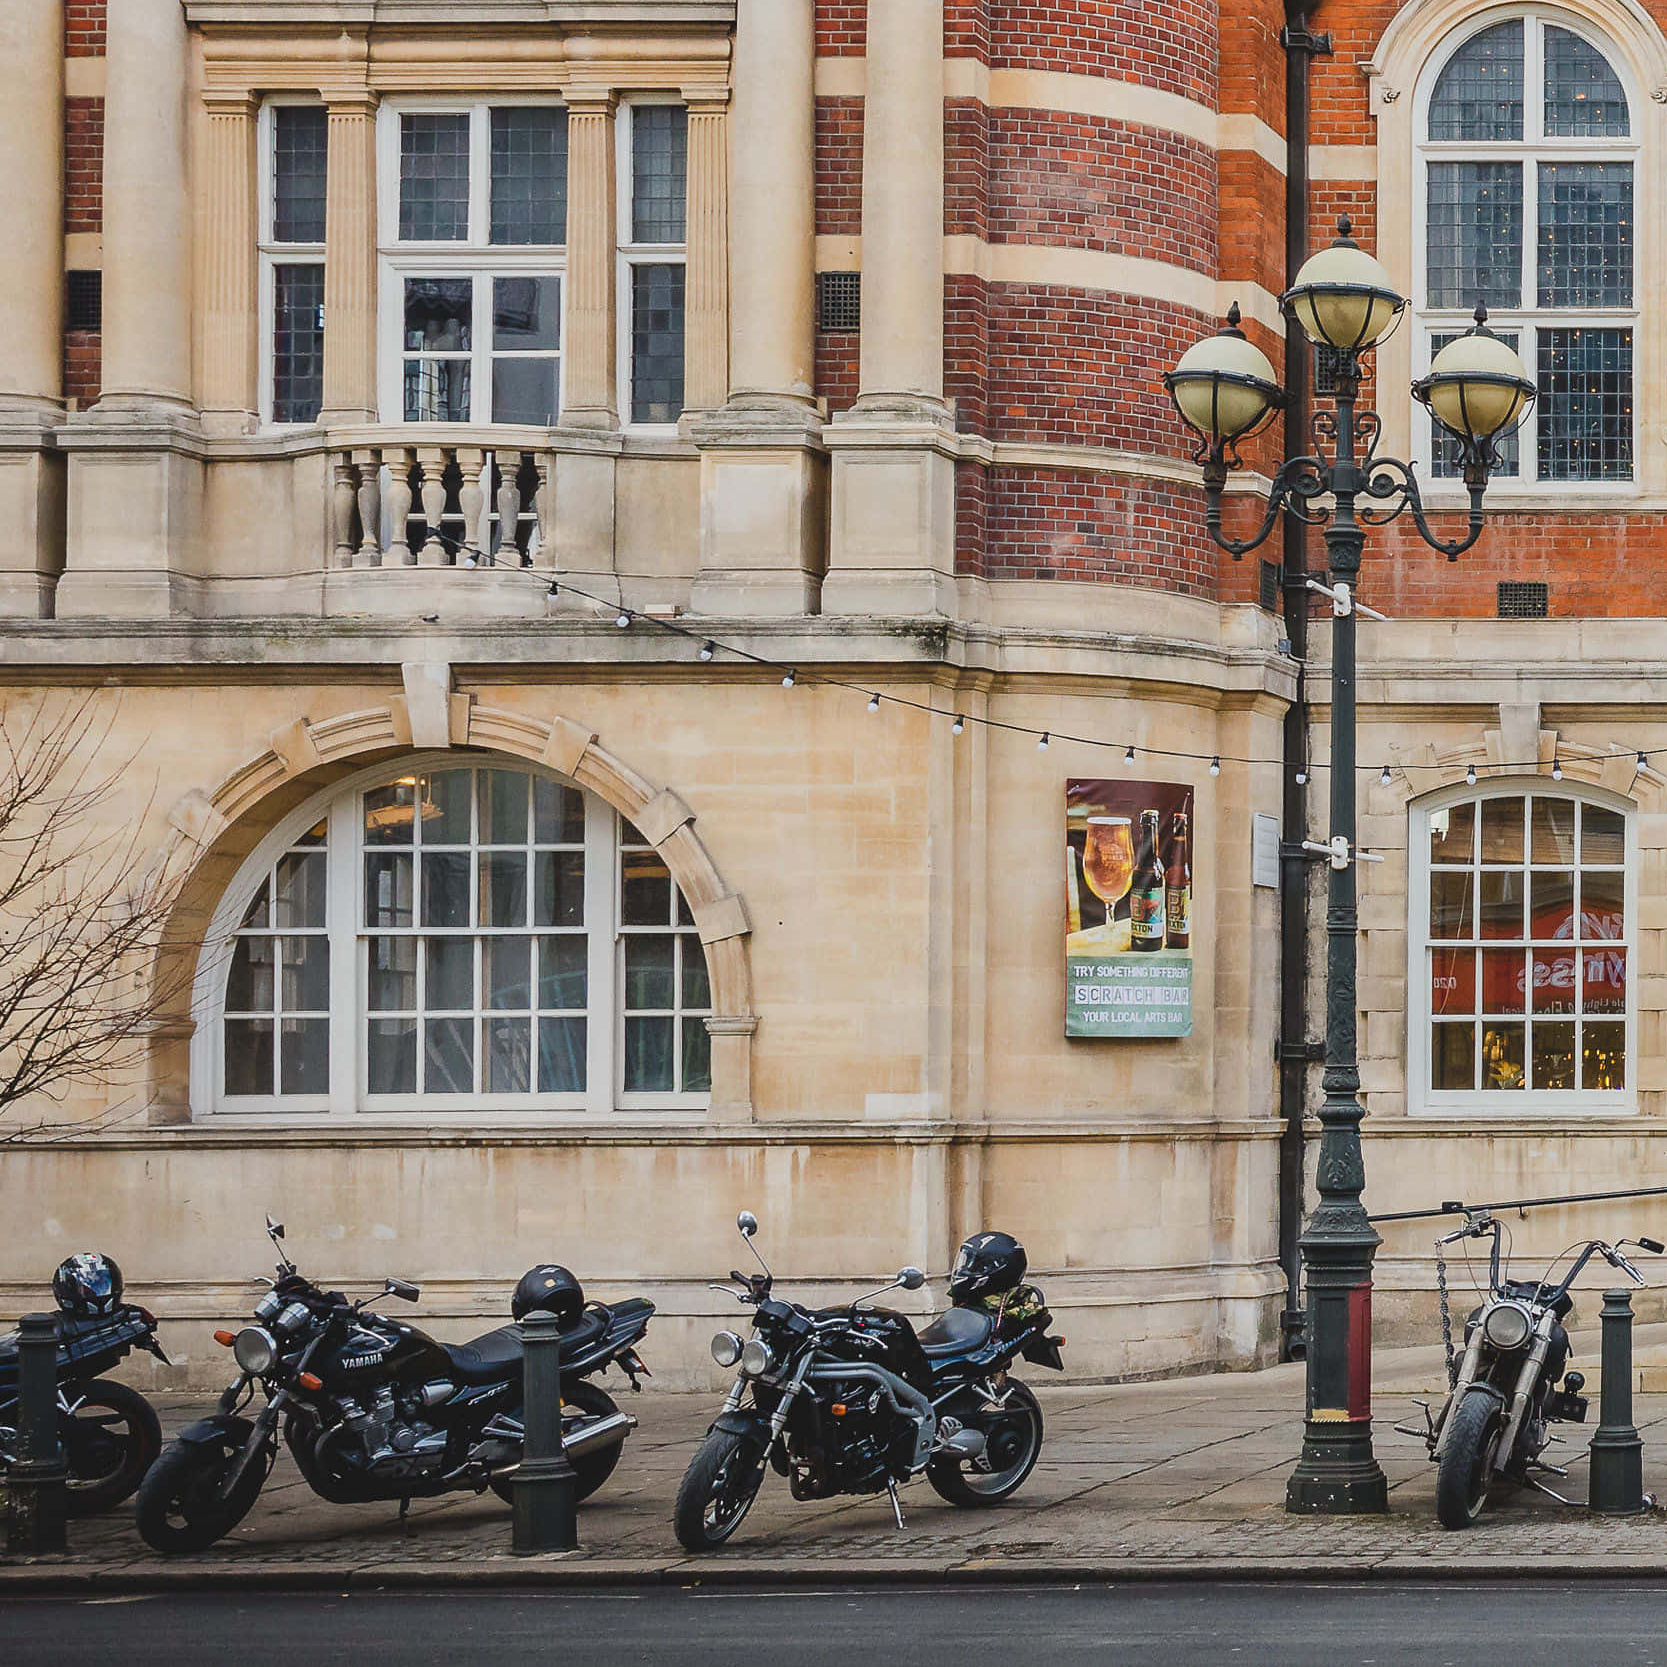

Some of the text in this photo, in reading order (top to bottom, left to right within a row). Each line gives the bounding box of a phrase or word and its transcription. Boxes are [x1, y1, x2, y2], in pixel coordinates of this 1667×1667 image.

[1074, 965, 1095, 977] TRY
[1096, 965, 1149, 978] SOMETHING
[1078, 987, 1188, 1003] SCRATCH BAR
[1083, 1011, 1183, 1023] YOUR LOCAL ARTS BAR
[341, 1352, 384, 1370] YAMAHA
